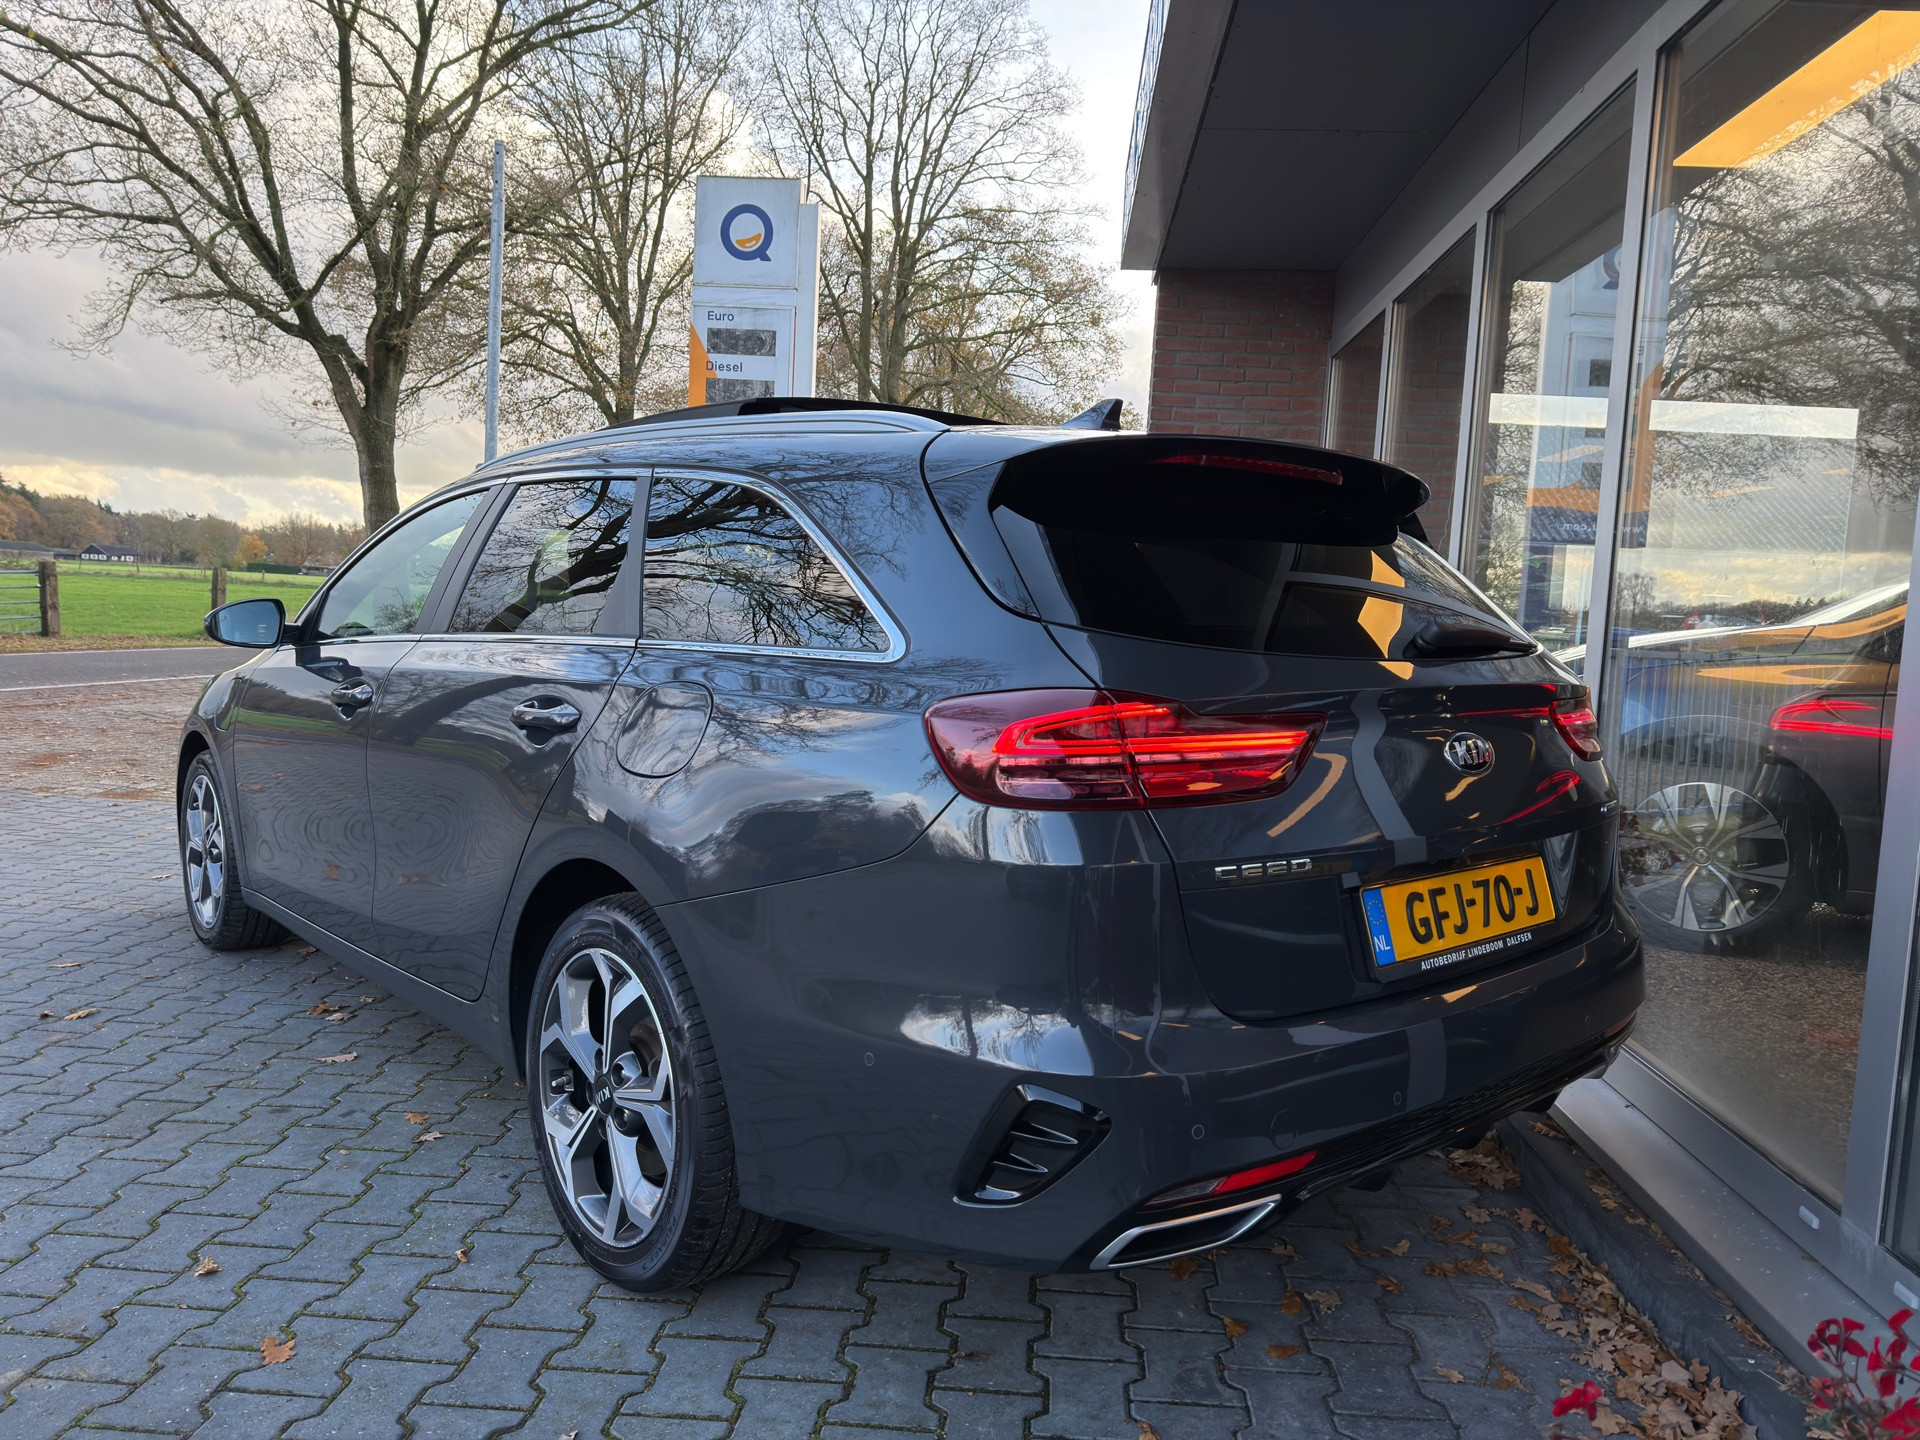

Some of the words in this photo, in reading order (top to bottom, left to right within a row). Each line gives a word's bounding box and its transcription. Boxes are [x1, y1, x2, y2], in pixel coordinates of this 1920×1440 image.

[707, 310, 735, 322] Euro
[705, 360, 743, 373] Diesel
[1452, 738, 1492, 766] KIA
[1405, 868, 1540, 945] GFJ-70-J
[1373, 934, 1391, 953] NL
[1421, 950, 1466, 971] AUTOBEDRIJF
[1467, 939, 1504, 959] LINDEBOOM
[1506, 931, 1533, 947] DALFSEN
